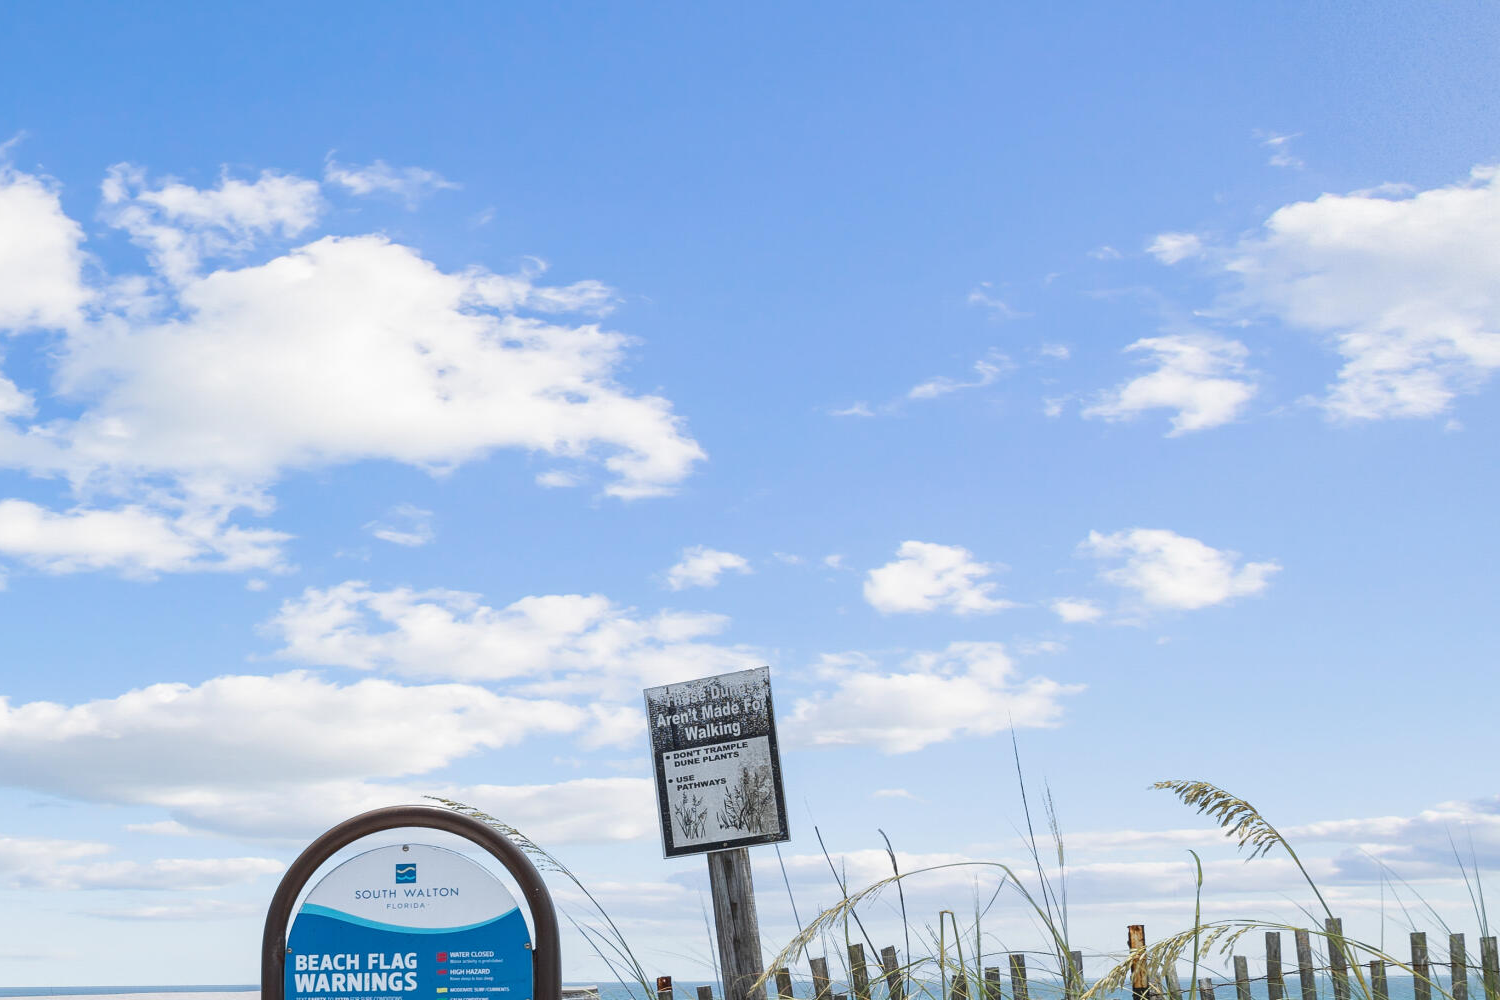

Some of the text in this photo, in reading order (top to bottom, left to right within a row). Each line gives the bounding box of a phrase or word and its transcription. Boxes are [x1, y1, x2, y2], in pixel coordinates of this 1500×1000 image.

[657, 698, 767, 727] Aren't Made For
[685, 721, 741, 741] Walking
[673, 741, 749, 760] DON'T TRAMPLE
[674, 751, 740, 768] DUNE PLANTS
[676, 774, 695, 783] USE
[677, 777, 727, 791] PATHWAYS
[355, 887, 459, 900] SOUTH WALTON
[386, 902, 426, 910] FLORIDA
[295, 952, 418, 971] BEACH FLAG
[294, 971, 418, 993] WARNINGS
